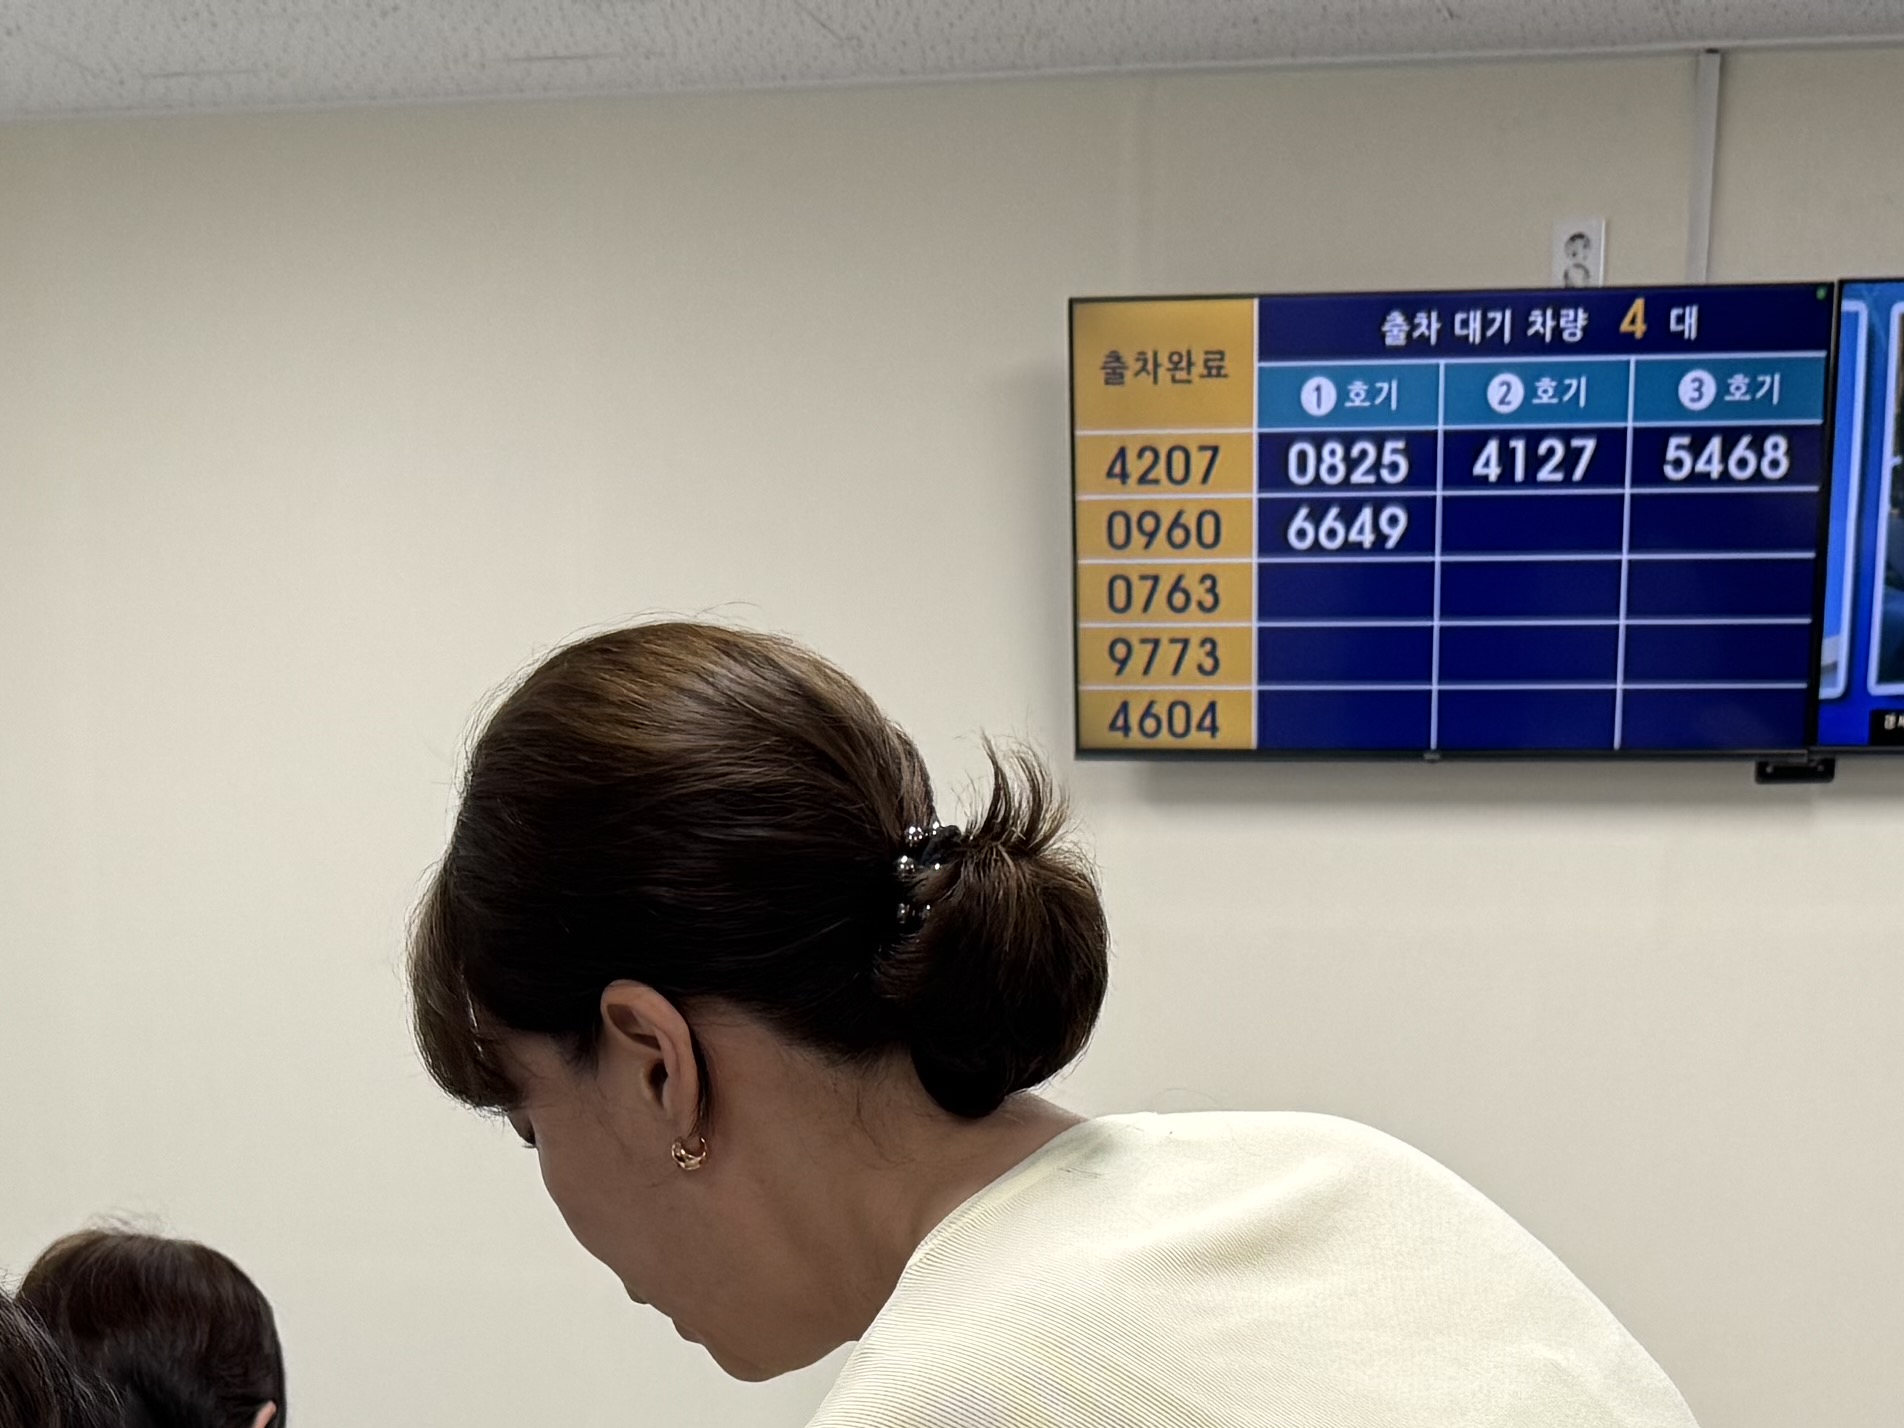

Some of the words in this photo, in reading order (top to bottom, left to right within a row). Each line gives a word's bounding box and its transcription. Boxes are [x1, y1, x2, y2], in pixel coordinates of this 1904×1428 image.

[1383, 304, 1440, 346] 출차
[1454, 305, 1512, 344] 대기
[1527, 303, 1588, 342] 차량
[1619, 297, 1647, 338] 4
[1670, 304, 1699, 340] 대
[1100, 347, 1229, 386] 출차완료
[1345, 378, 1400, 412] 호기
[1532, 375, 1588, 409] 호기
[1724, 373, 1781, 406] 호기
[1106, 446, 1221, 487] 4207
[1287, 439, 1410, 486] 0825
[1473, 437, 1598, 481] 4127
[1662, 434, 1790, 481] 5468
[1107, 509, 1222, 551] 0960
[1287, 504, 1408, 551] 6649
[1108, 572, 1221, 615] 0763
[1108, 635, 1221, 678] 9773
[1108, 697, 1220, 740] 4604
